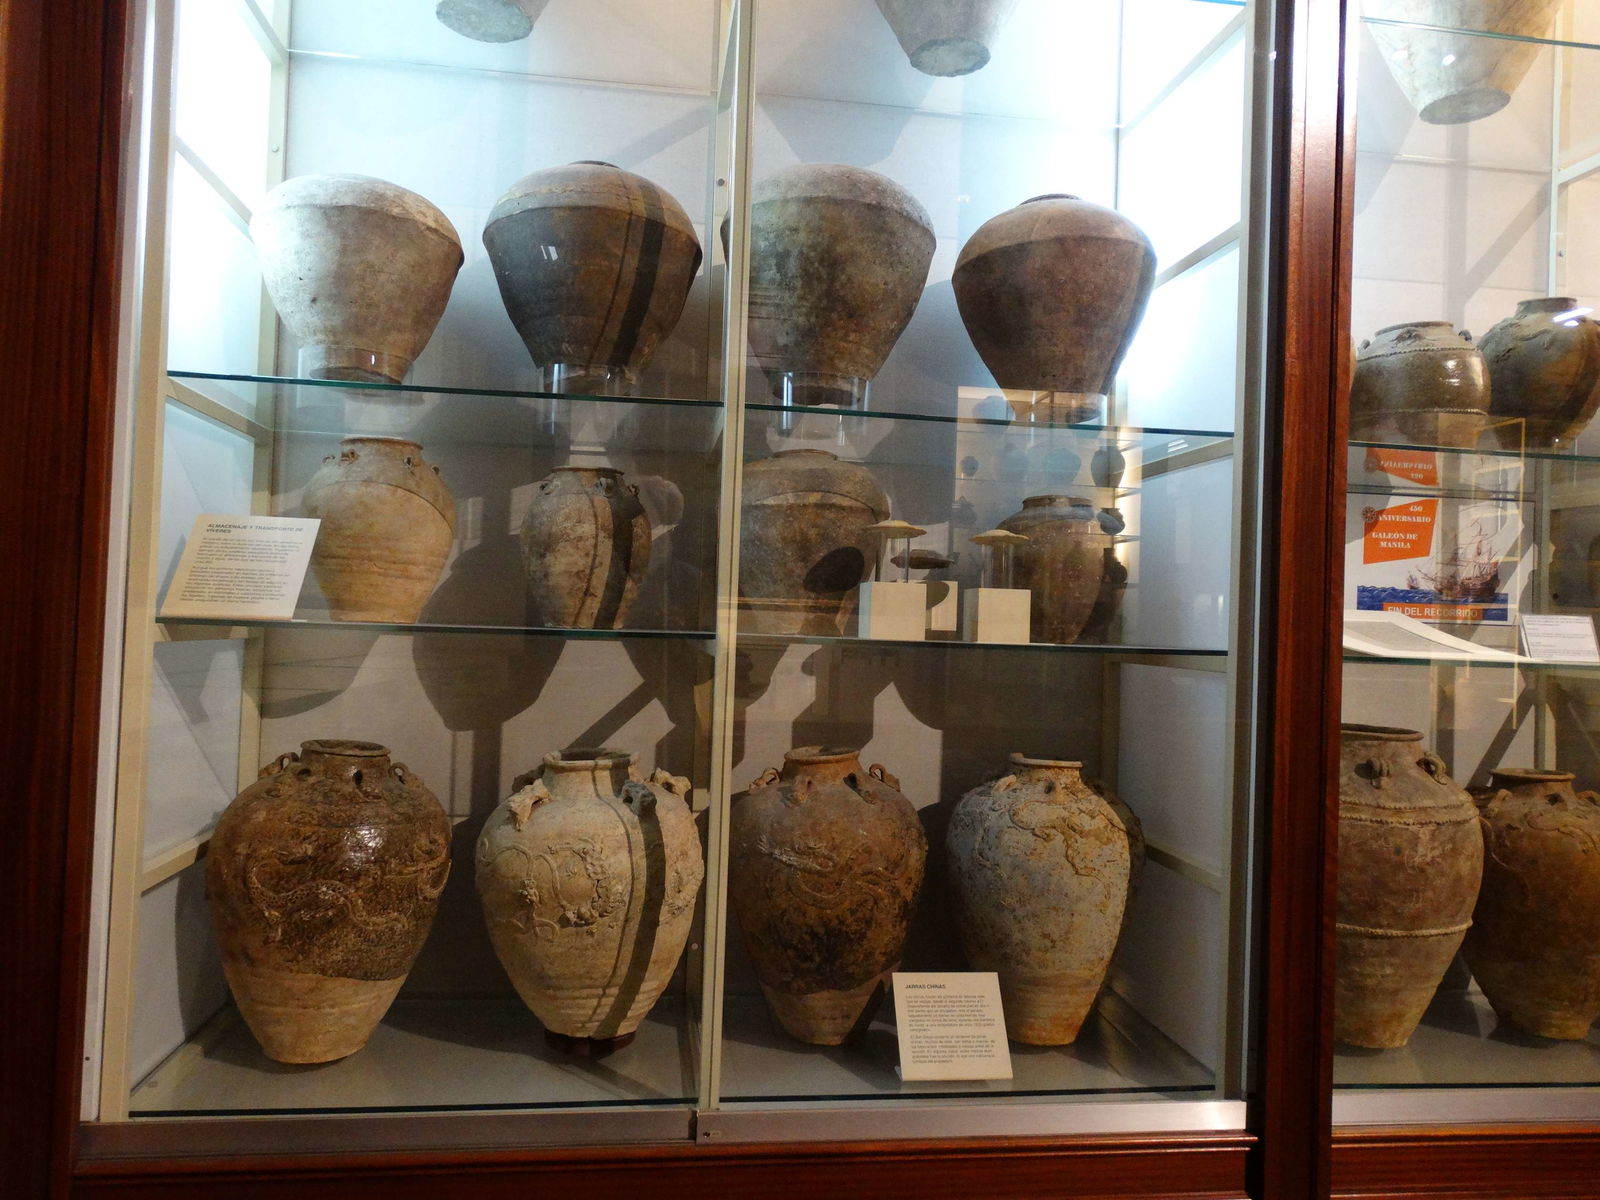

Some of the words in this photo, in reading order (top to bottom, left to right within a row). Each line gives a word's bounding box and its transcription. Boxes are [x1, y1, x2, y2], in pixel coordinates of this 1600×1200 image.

[1379, 514, 1431, 523] ANIVERSARIO
[1371, 531, 1405, 539] GALEÓN
[1380, 541, 1411, 549] MANILA
[1388, 606, 1403, 614] FIN
[1404, 607, 1422, 616] DEL
[1424, 607, 1478, 617] RECORRIDO
